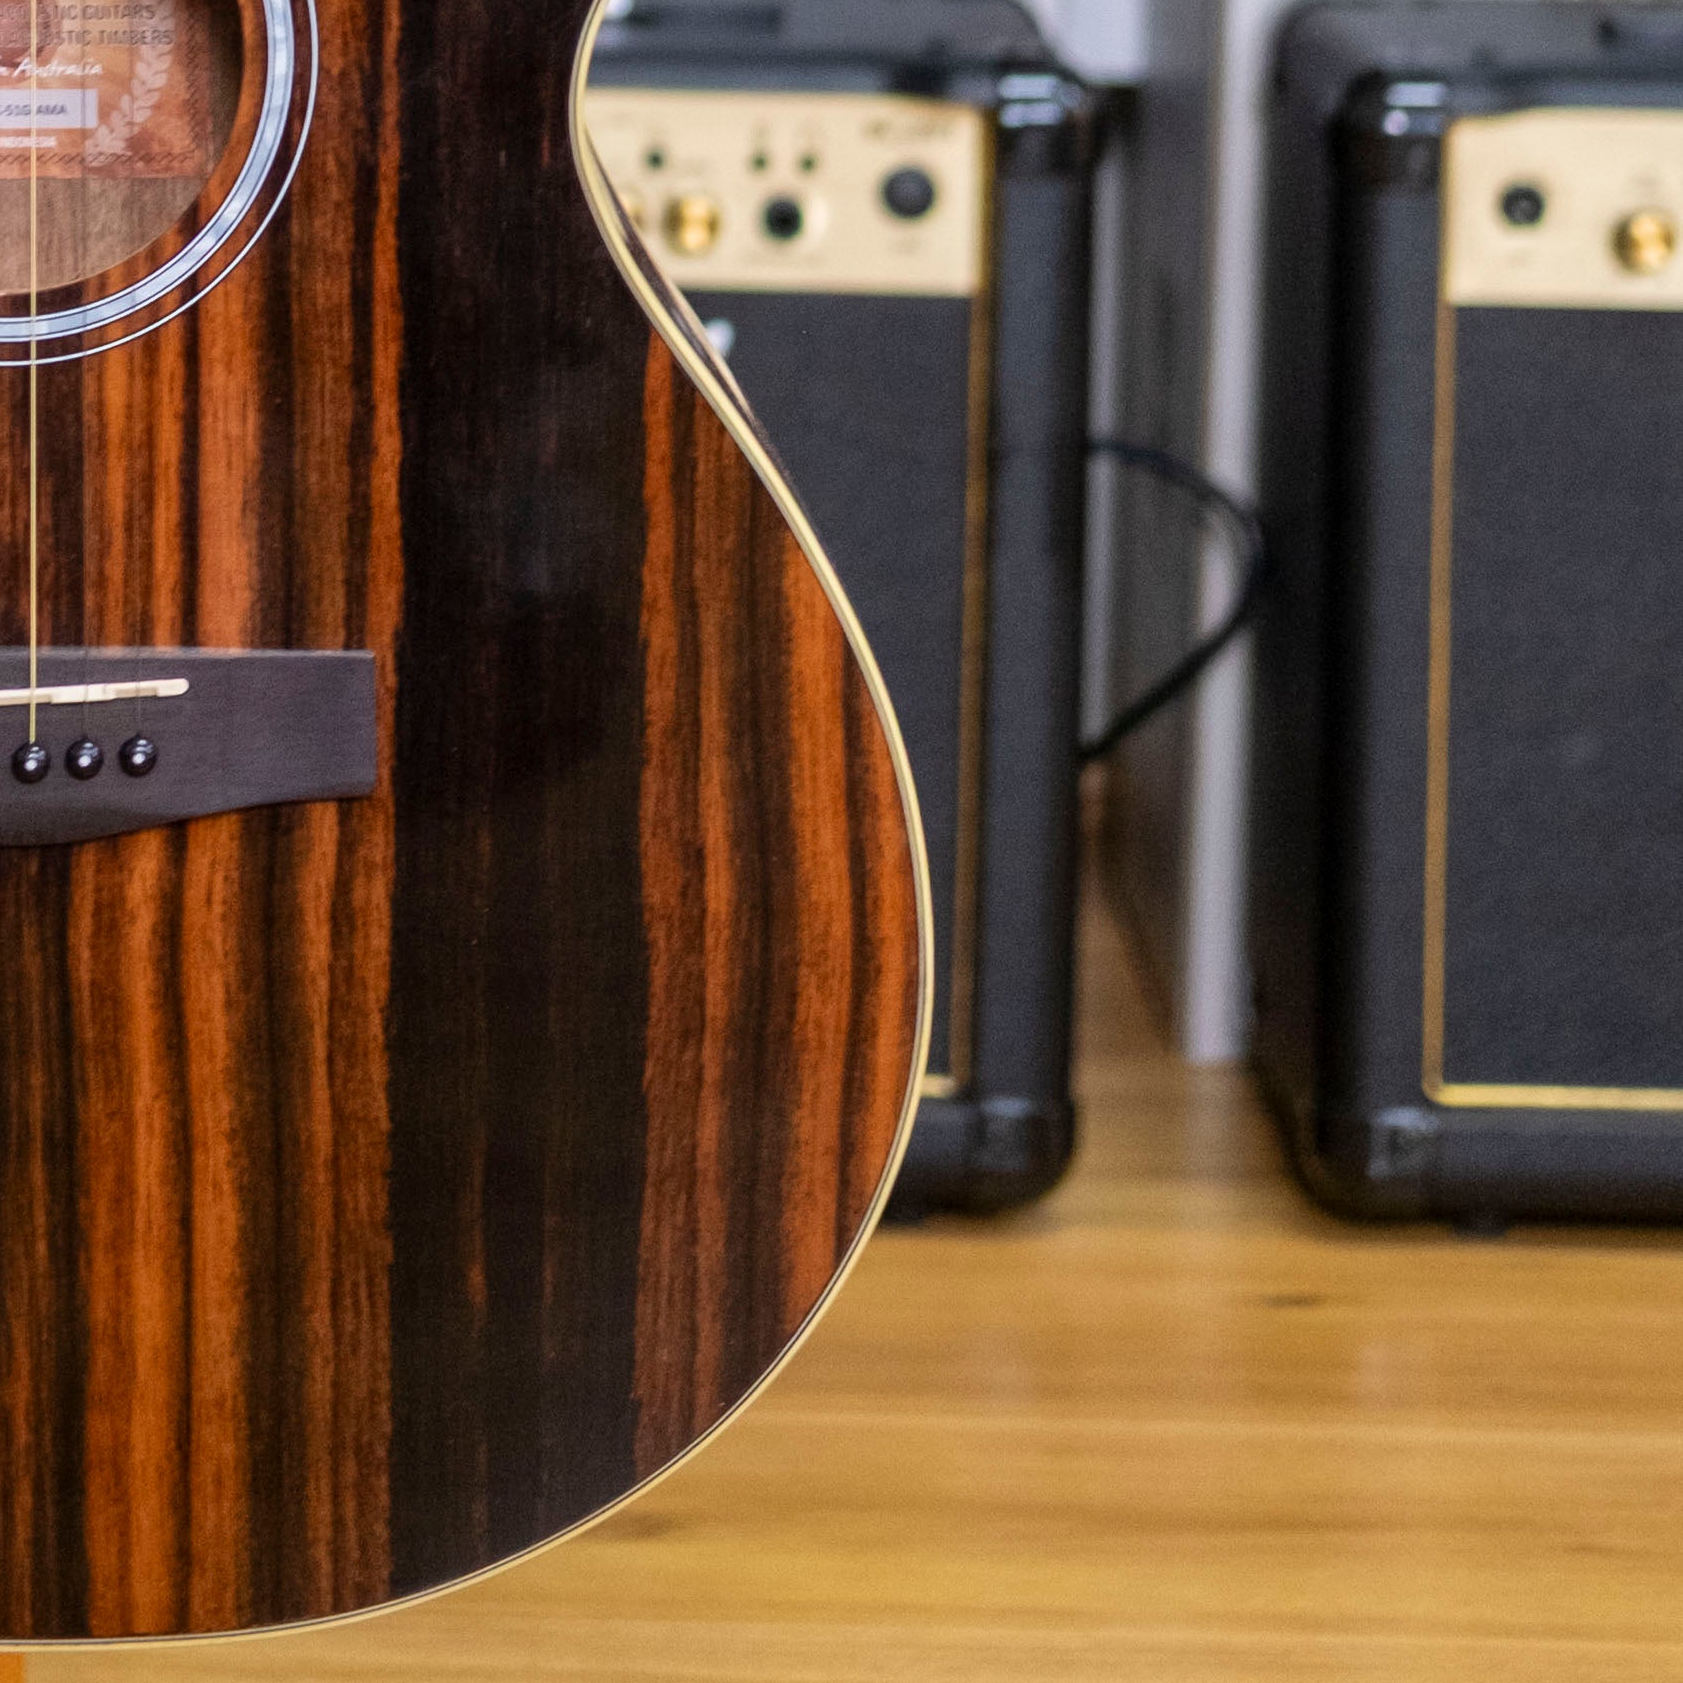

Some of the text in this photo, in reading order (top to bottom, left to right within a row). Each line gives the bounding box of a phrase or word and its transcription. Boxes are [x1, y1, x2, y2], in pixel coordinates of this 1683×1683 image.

[82, 4, 155, 20] GUITARS
[98, 30, 175, 46] TIMBERS
[11, 57, 104, 78] Australia
